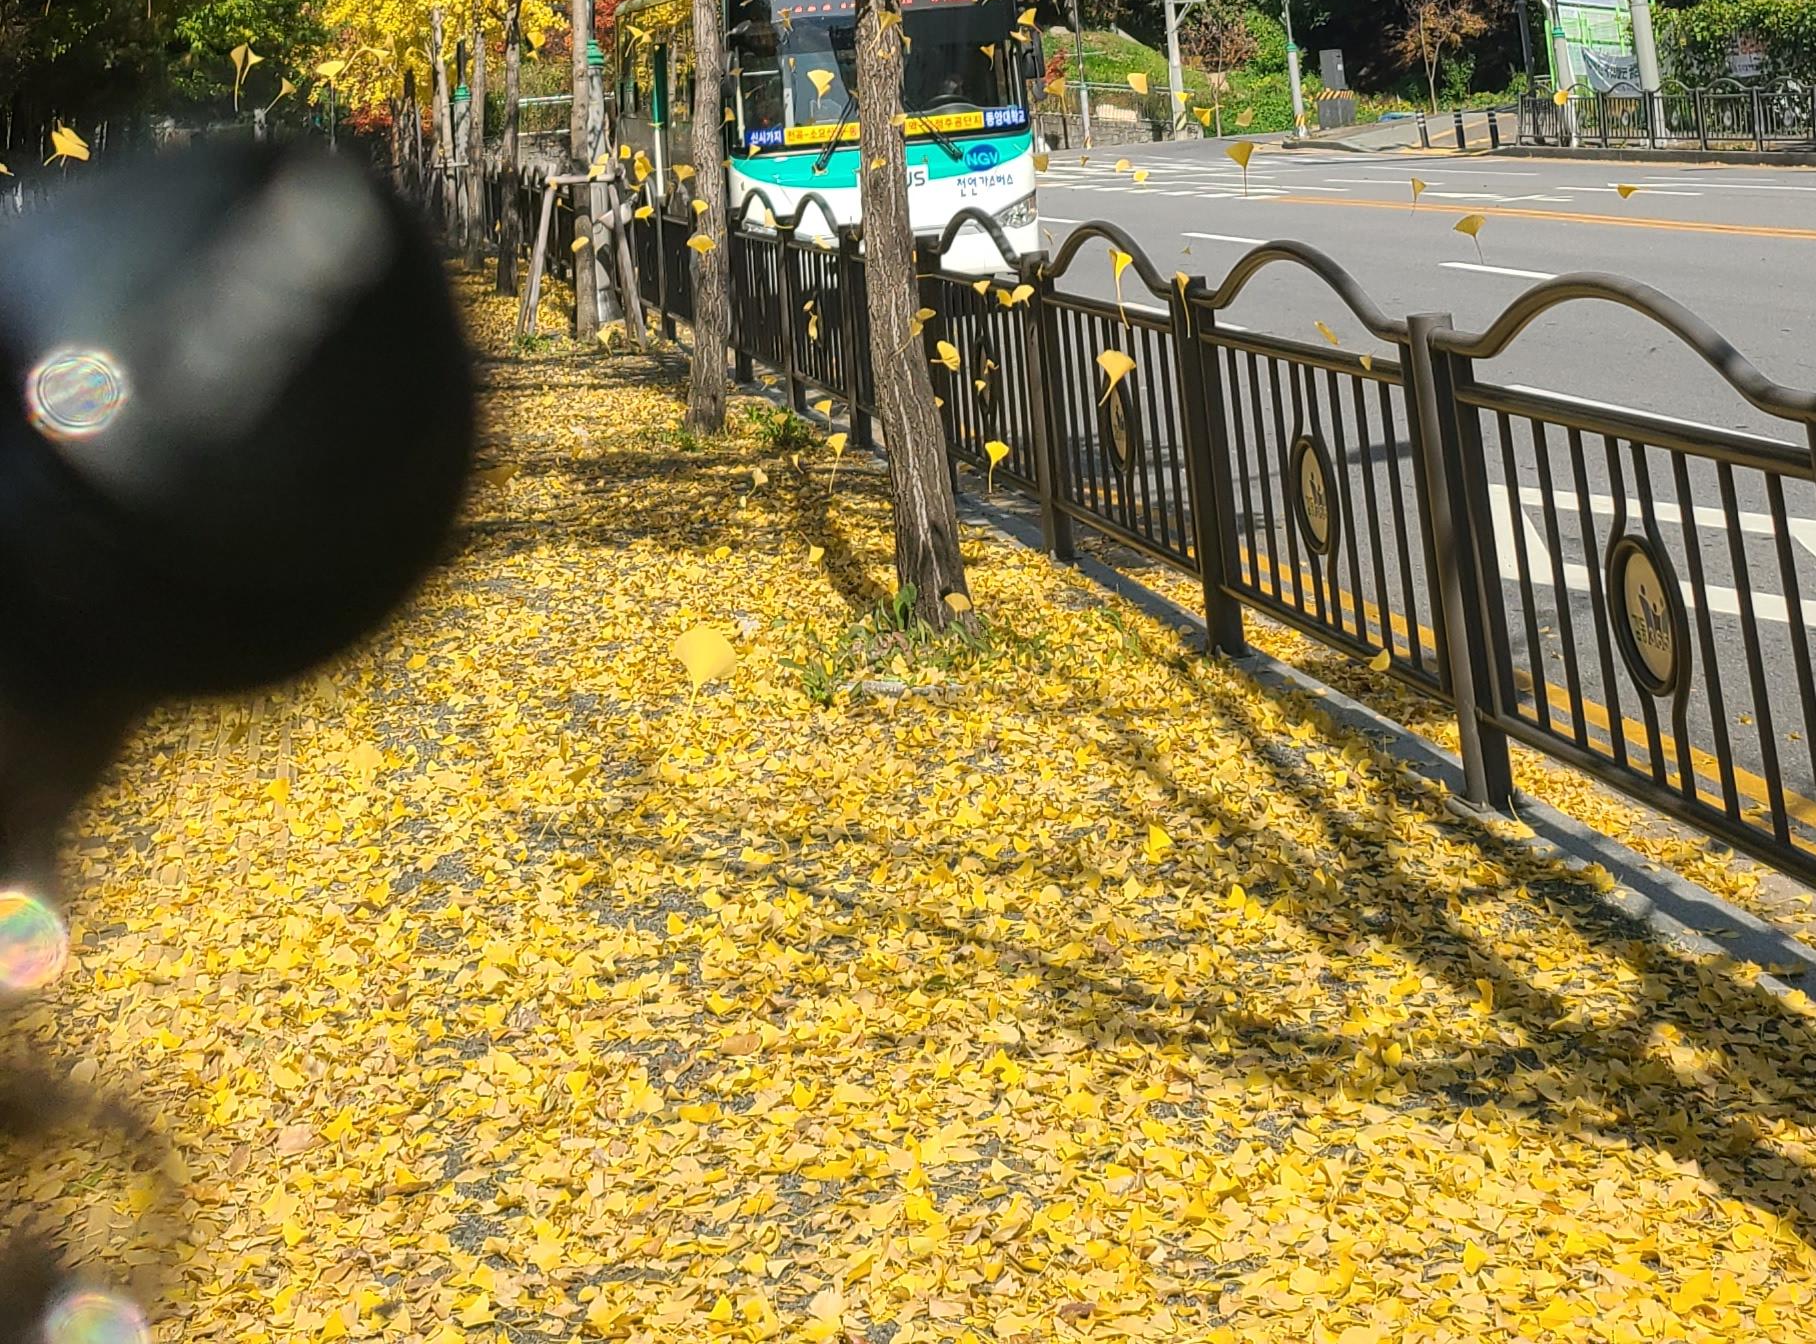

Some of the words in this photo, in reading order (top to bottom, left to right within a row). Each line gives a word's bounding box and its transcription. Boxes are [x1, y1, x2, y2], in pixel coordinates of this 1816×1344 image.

[985, 110, 1025, 128] 동양대학교
[750, 129, 783, 144] 신시가지
[966, 152, 998, 167] NGV
[956, 174, 1014, 197] 천연가스버스
